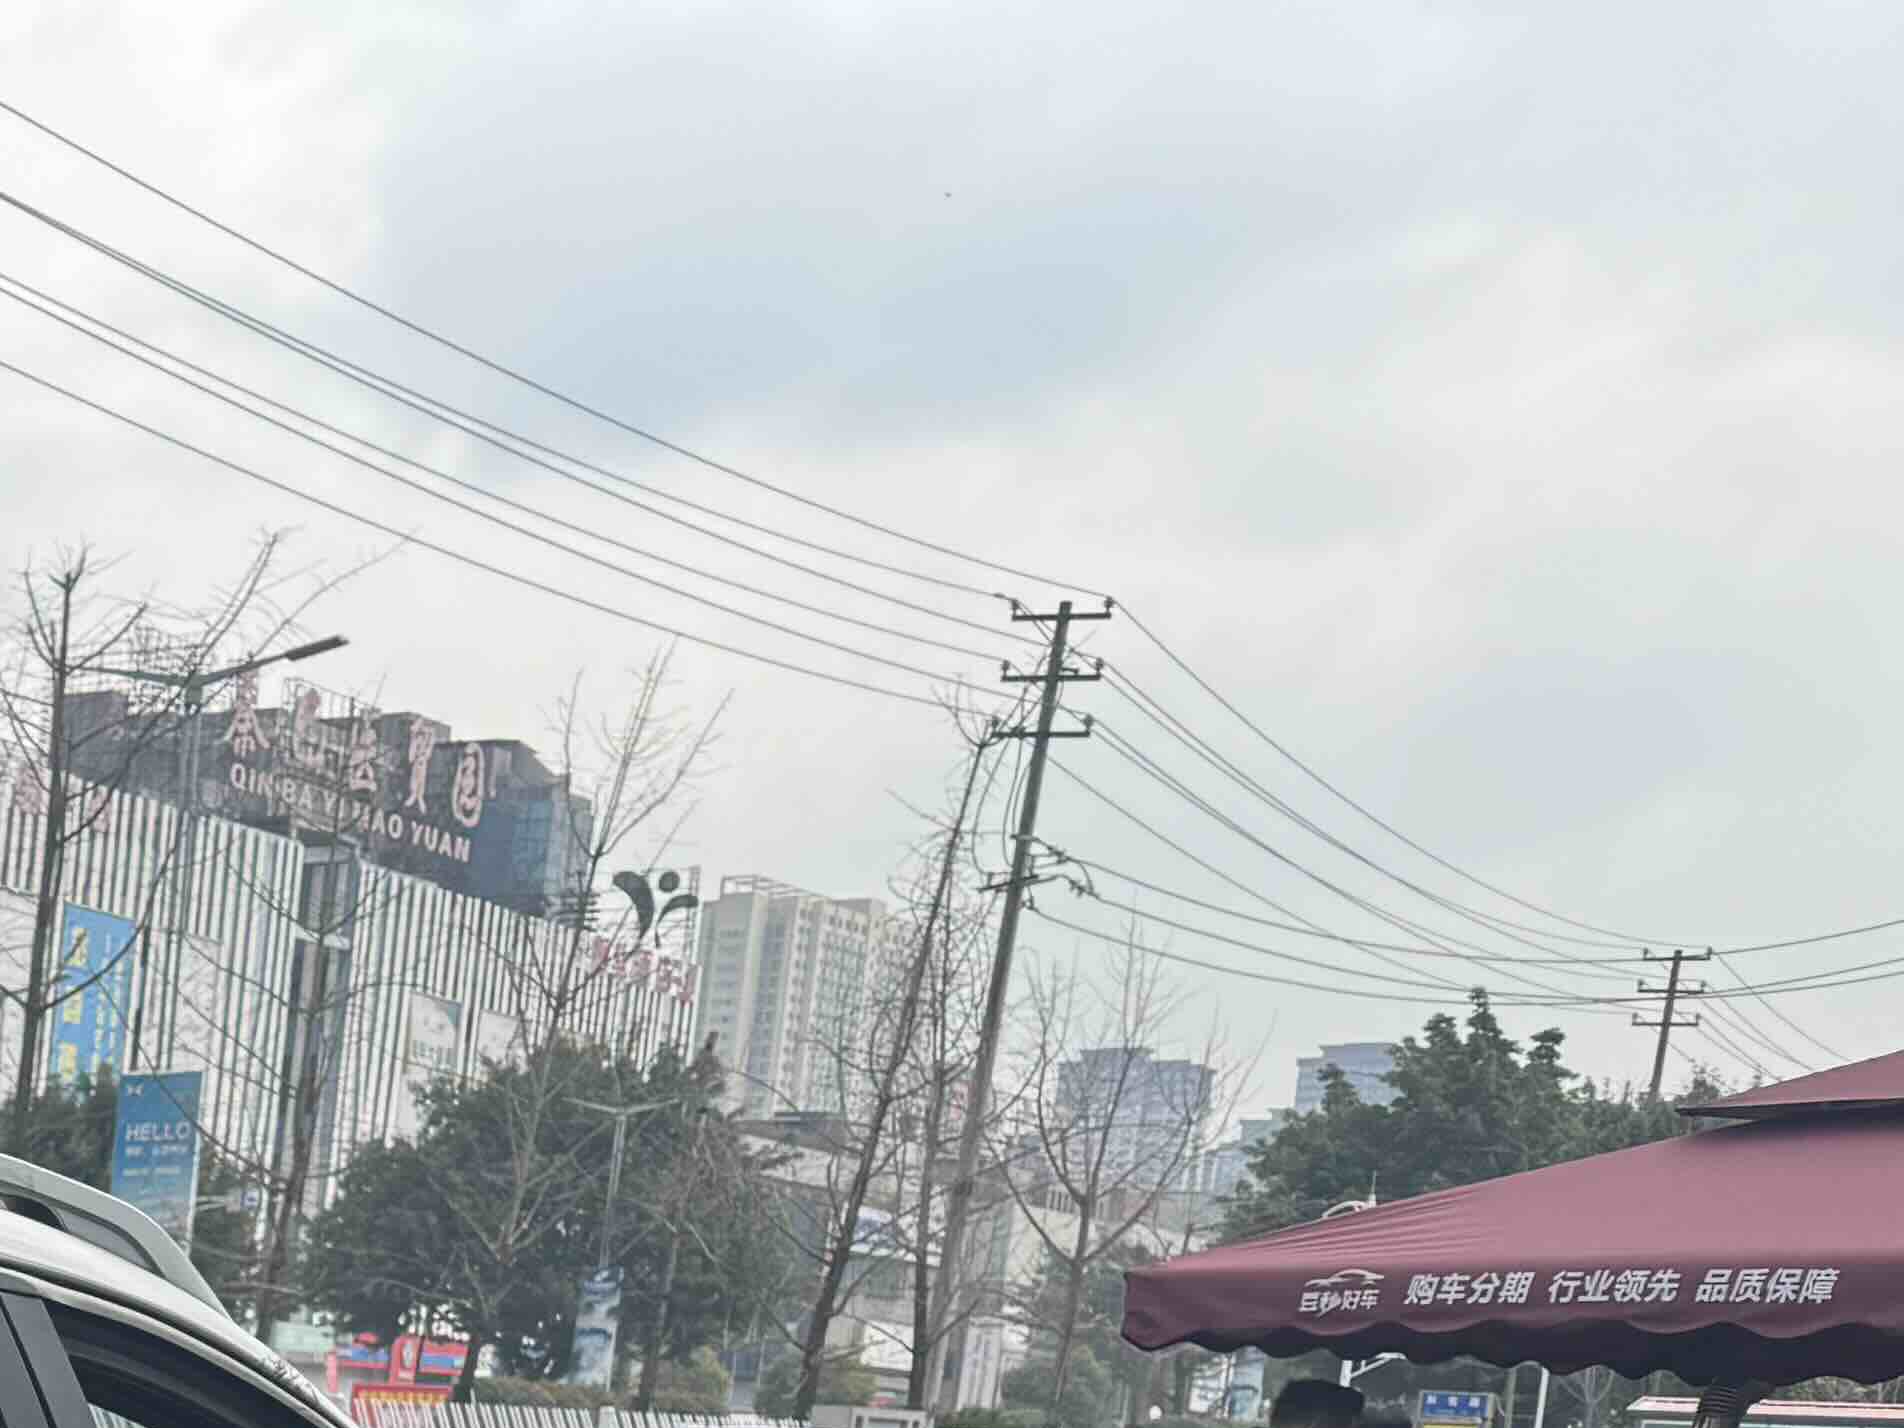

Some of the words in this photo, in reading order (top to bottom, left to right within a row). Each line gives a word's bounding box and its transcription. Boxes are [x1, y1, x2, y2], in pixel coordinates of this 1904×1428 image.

[410, 818, 472, 863] YUAN
[125, 1121, 190, 1141] HELLO
[1403, 1271, 1535, 1305] 购车分期
[1548, 1269, 1682, 1303] 行业领先
[1694, 1267, 1841, 1304] 品质保障
